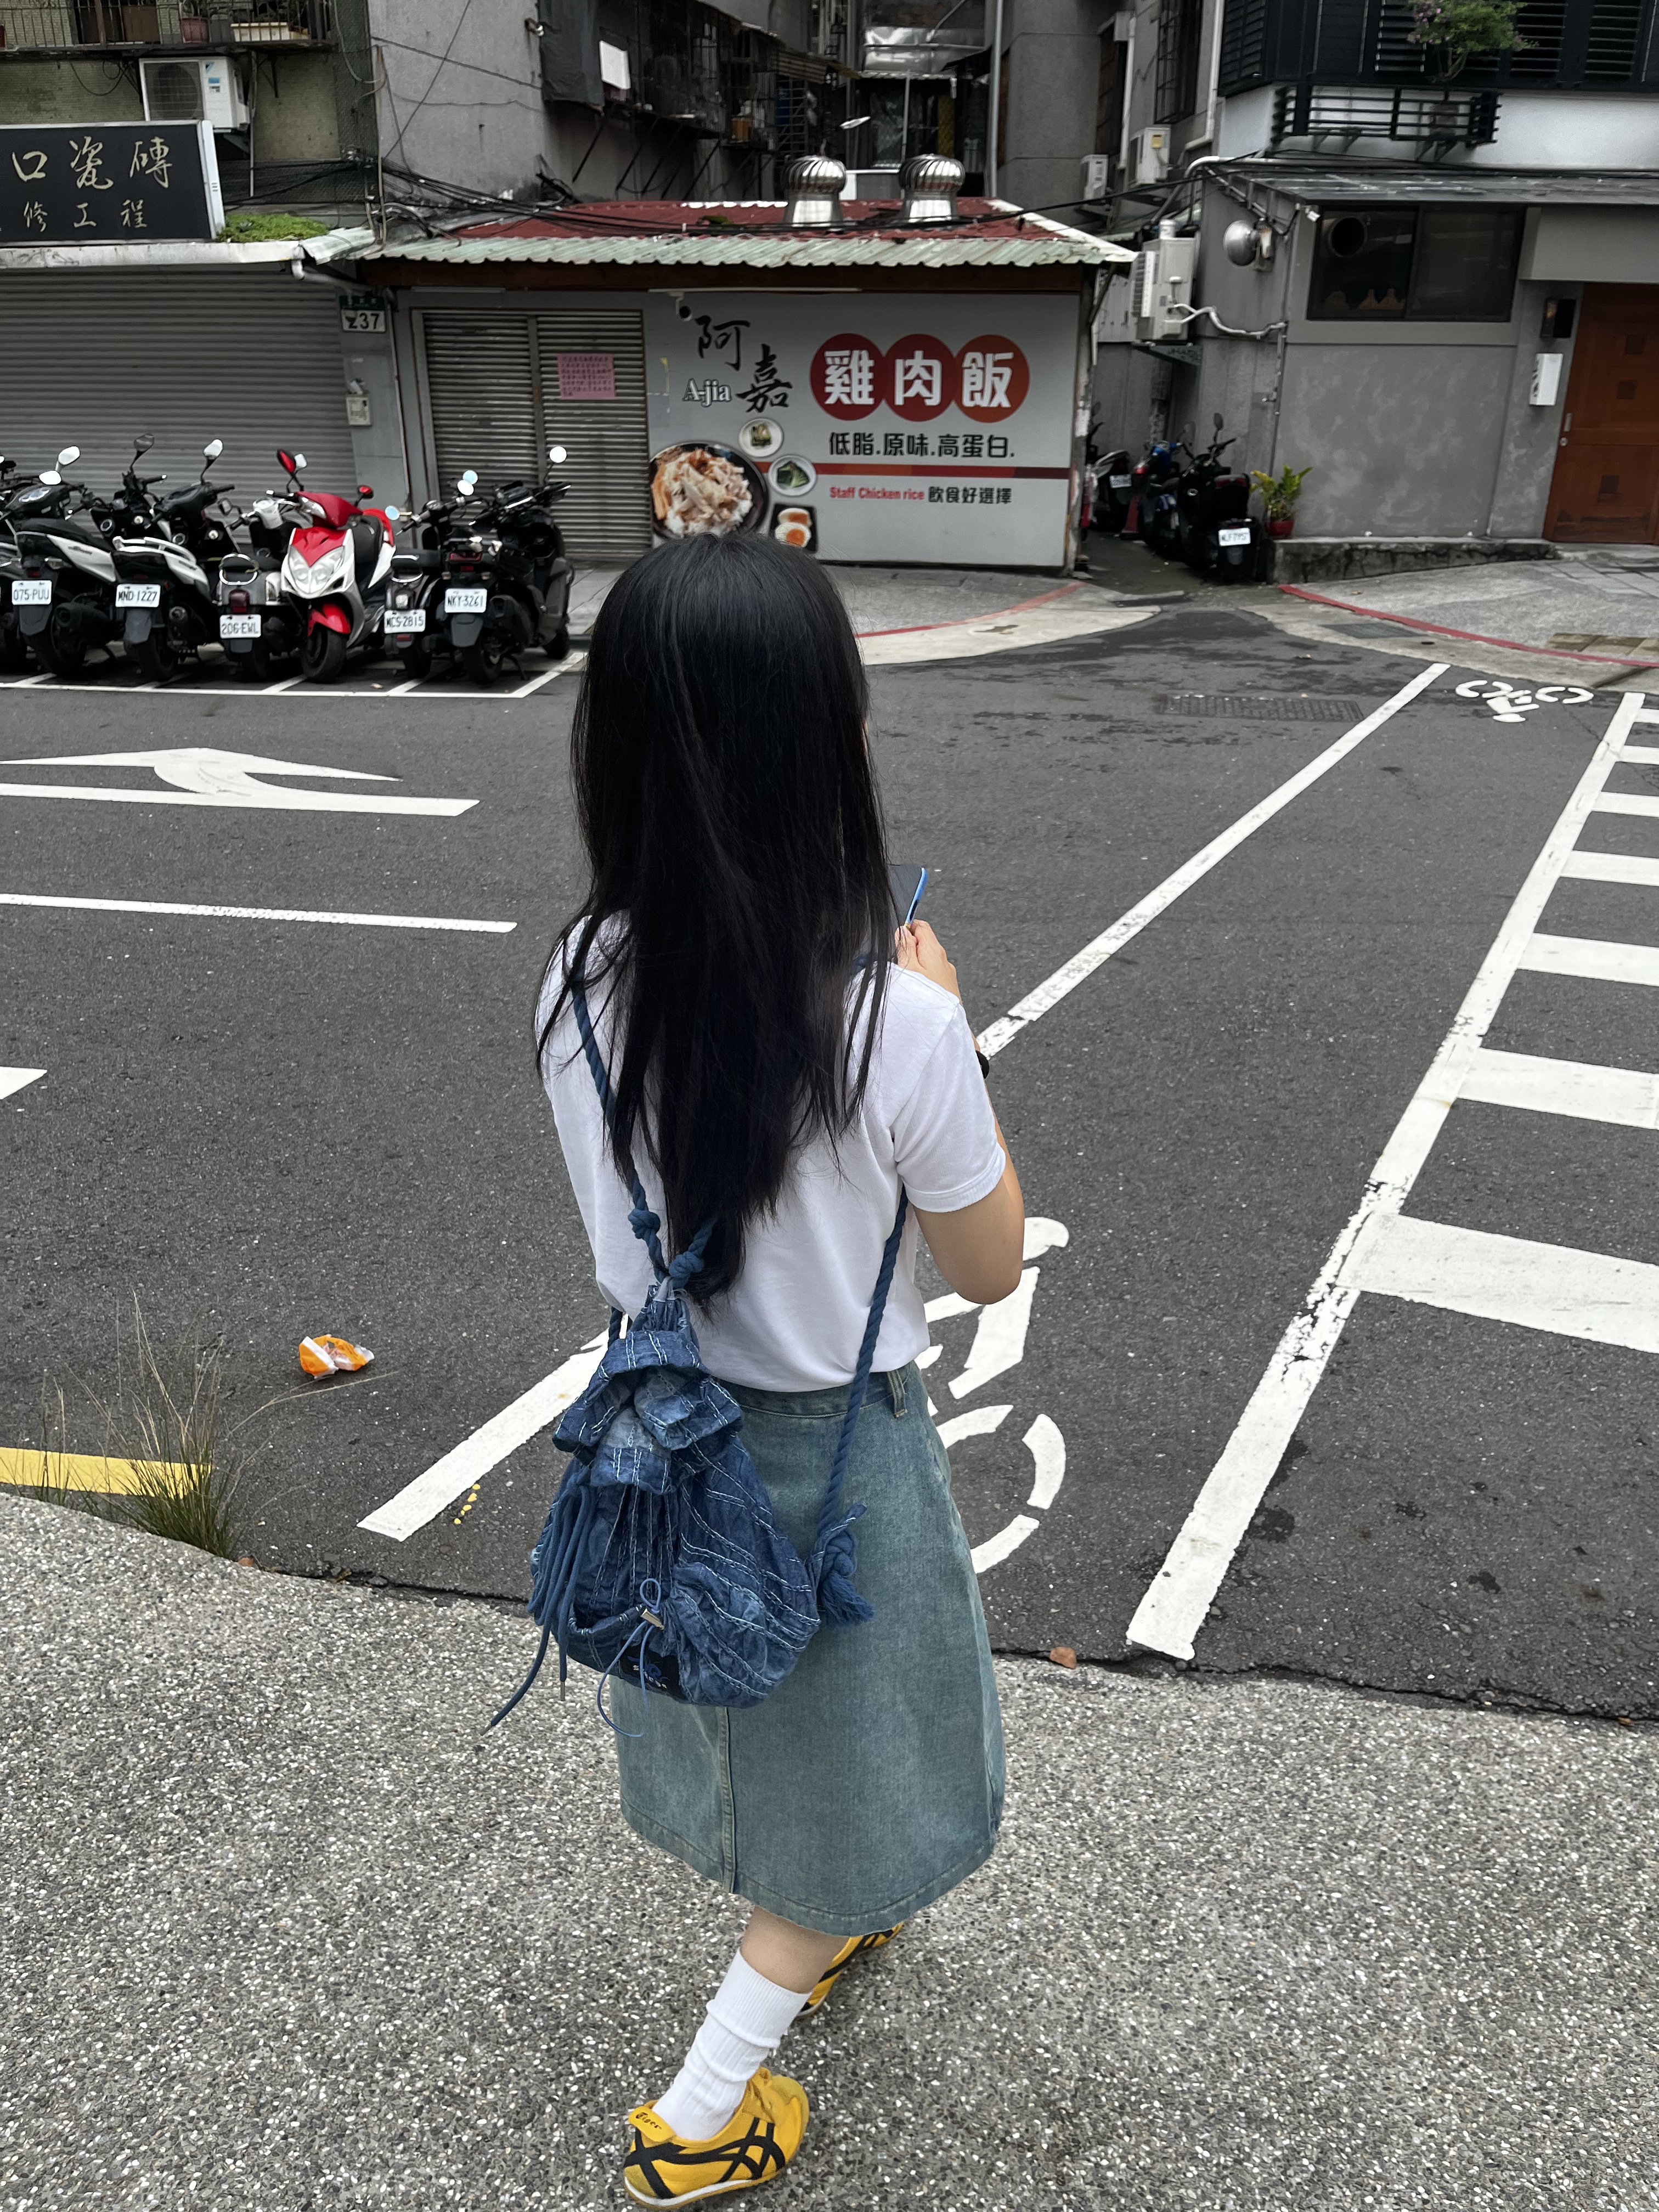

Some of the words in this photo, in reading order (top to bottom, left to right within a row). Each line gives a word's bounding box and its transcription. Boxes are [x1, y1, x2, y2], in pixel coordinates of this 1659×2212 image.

[0, 199, 147, 233] 修工程
[695, 315, 793, 413] 阿嘉
[824, 349, 1014, 408] 雞肉飯
[682, 377, 732, 407] A-jia
[829, 487, 855, 499] Staff
[858, 487, 901, 500] Chicken
[903, 488, 925, 501] rice
[928, 486, 1012, 505] 飲食好選擇
